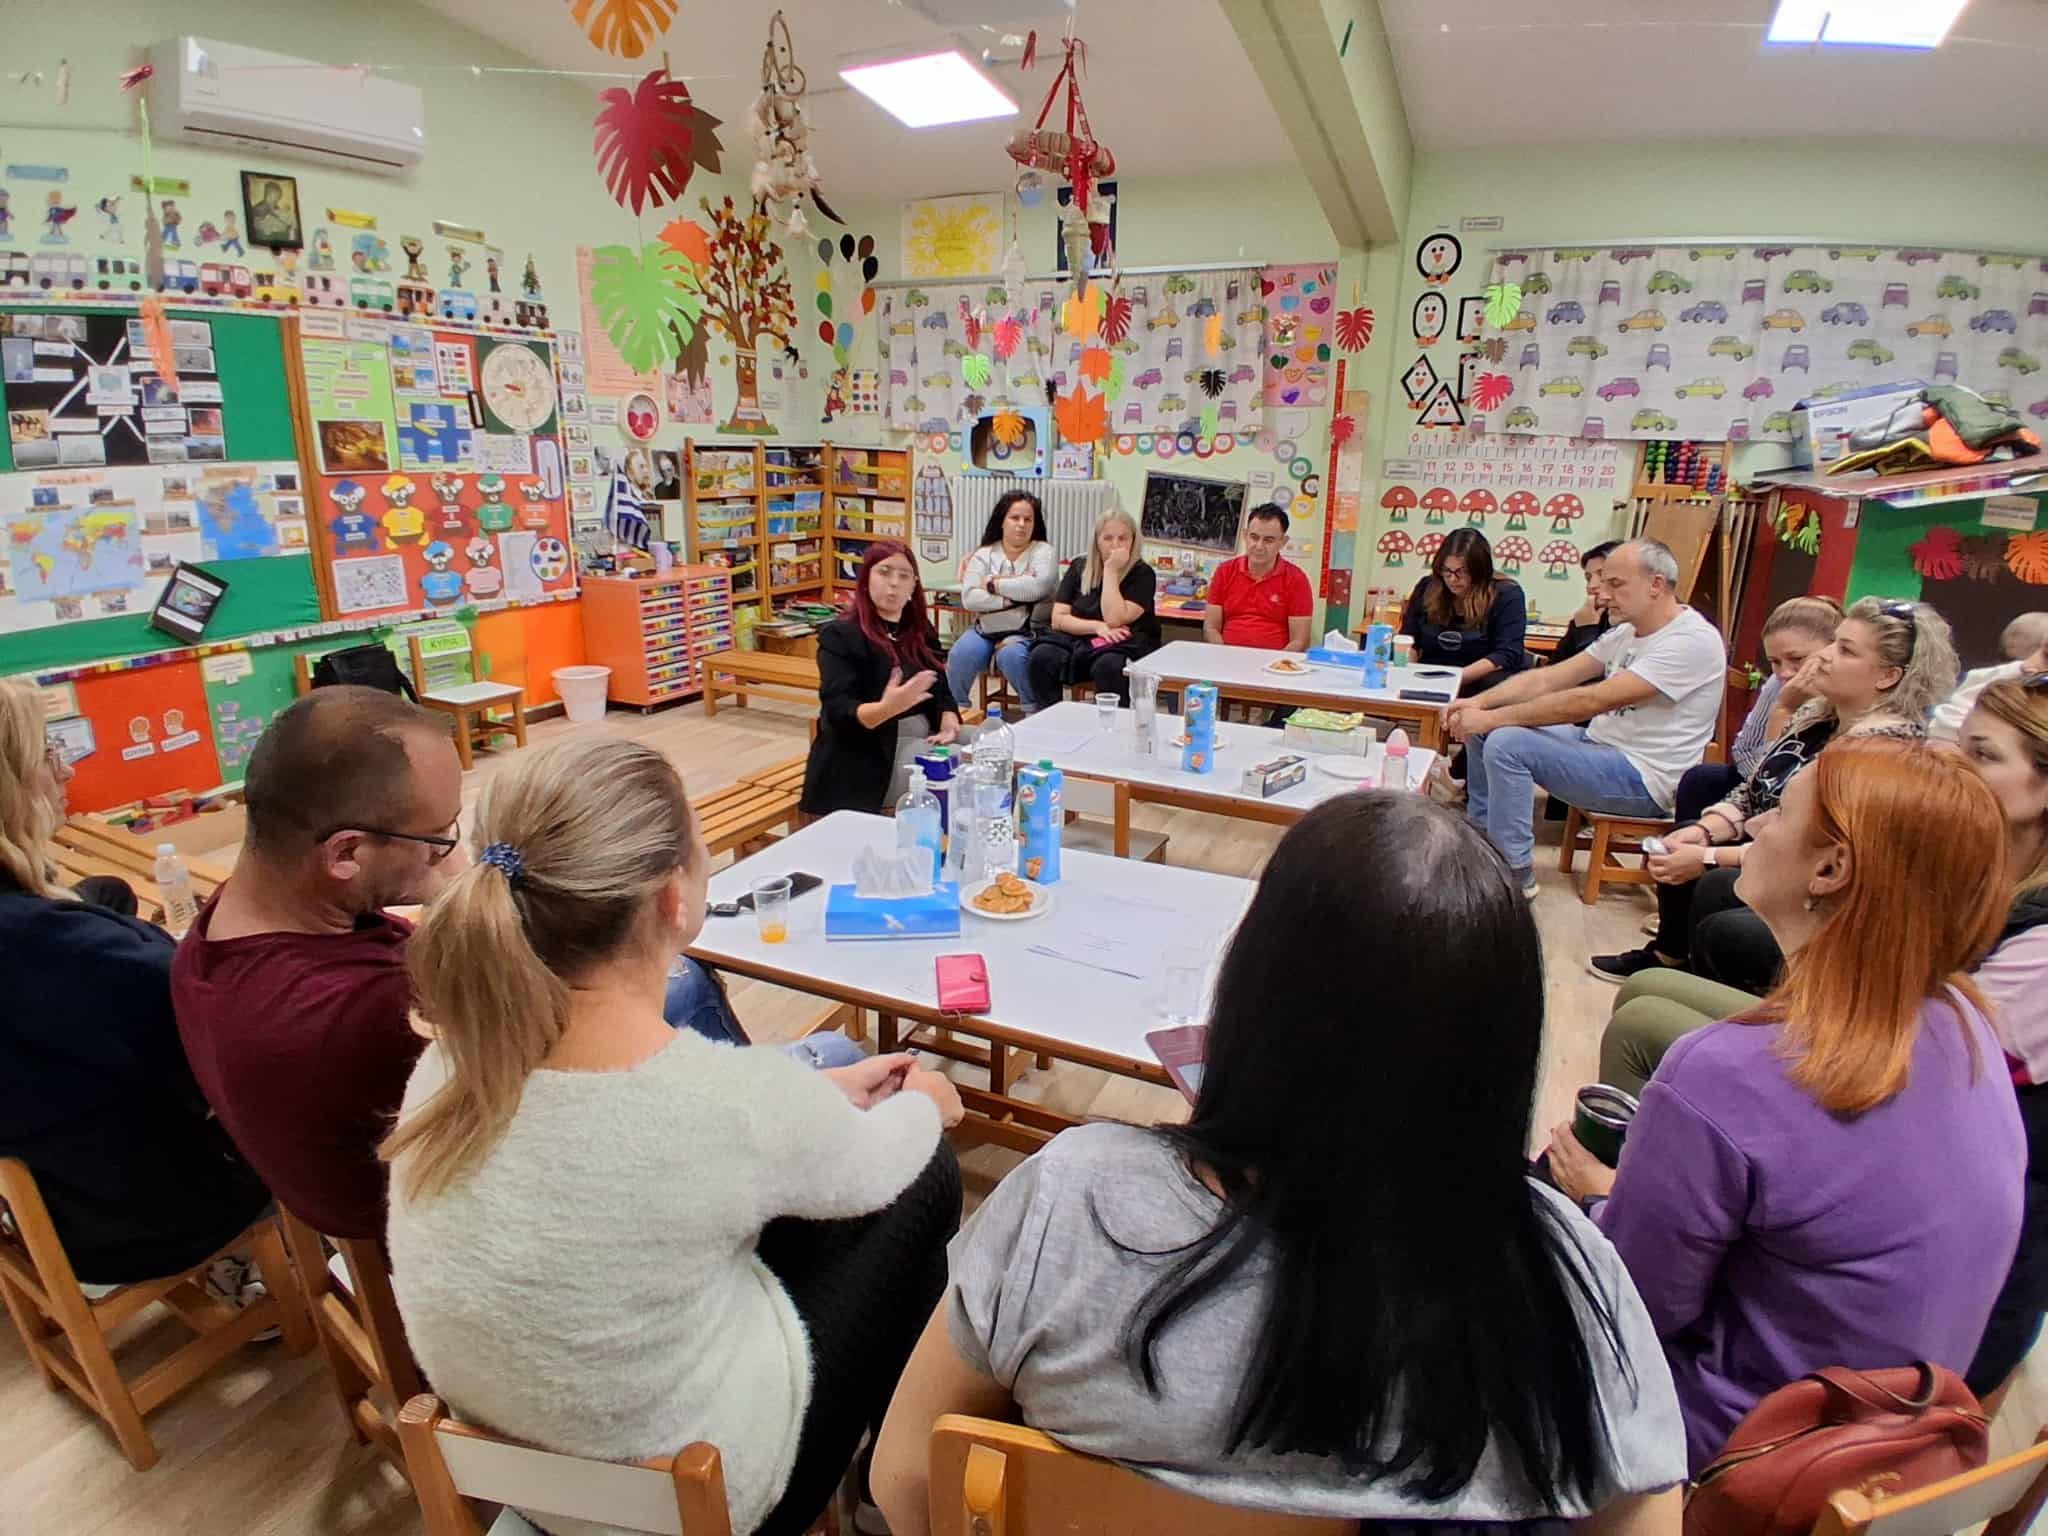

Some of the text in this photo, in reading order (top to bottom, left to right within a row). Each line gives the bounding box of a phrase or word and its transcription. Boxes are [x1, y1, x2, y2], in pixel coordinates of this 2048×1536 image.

[1427, 461, 1616, 475] 11 12 13 14 15 16 17 18 19 20
